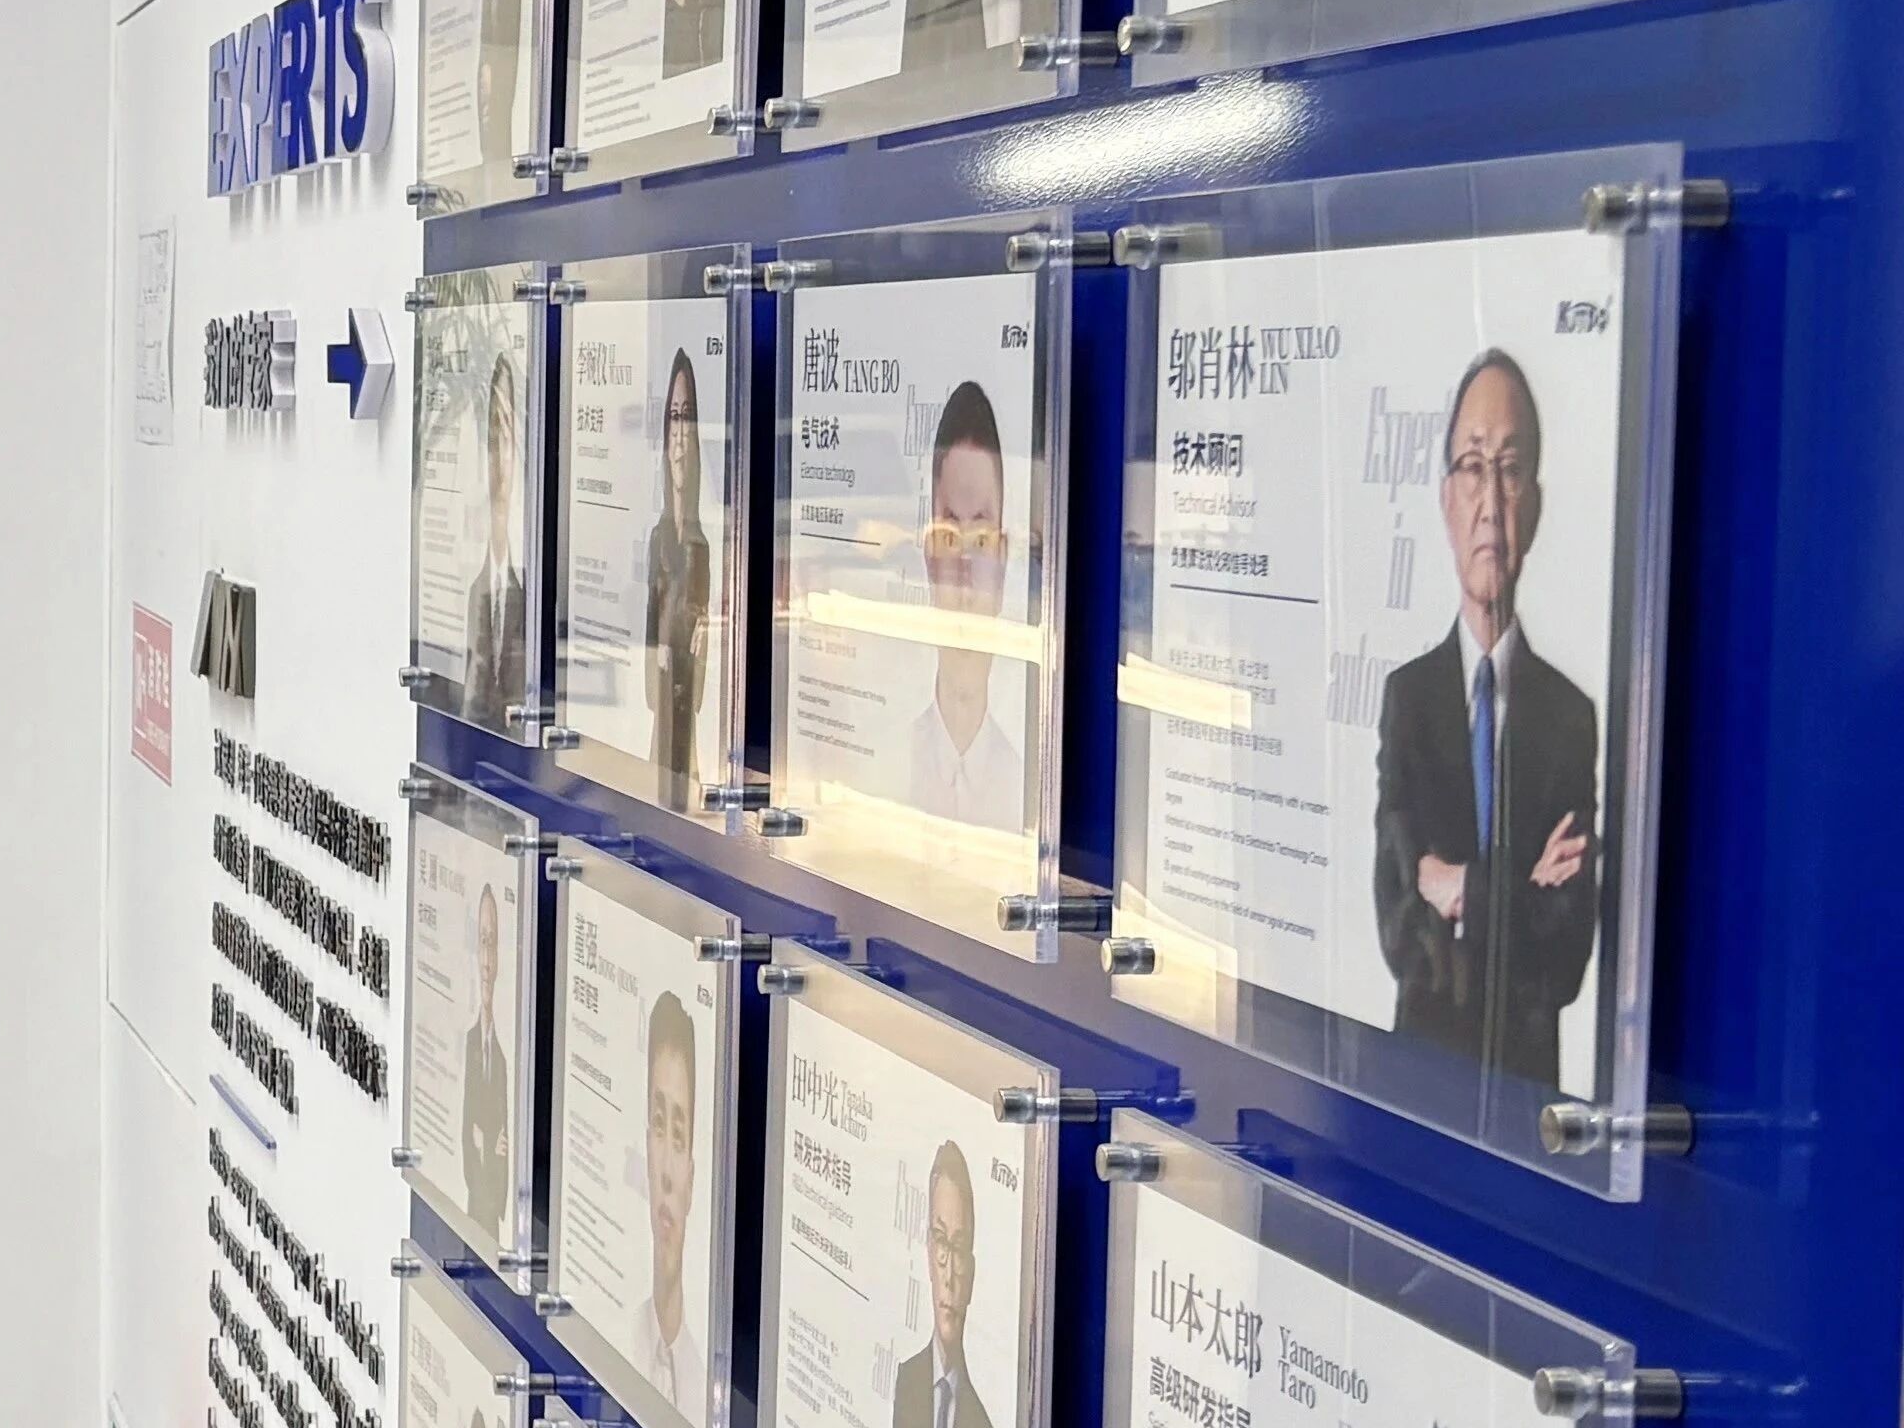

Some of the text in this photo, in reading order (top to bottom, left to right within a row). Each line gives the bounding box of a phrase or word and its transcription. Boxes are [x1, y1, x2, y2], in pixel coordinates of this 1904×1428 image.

[802, 327, 840, 393] 唐波
[843, 358, 900, 394] TANG BO
[801, 415, 840, 451] 电气技术
[1173, 430, 1244, 478] 技术顾问
[791, 1053, 838, 1128] 田中光
[794, 1129, 851, 1196] 研发技术指导
[1150, 1259, 1263, 1380] 山本太郎
[1278, 1359, 1316, 1409] Taro
[1279, 1325, 1369, 1405] Yamamoto
